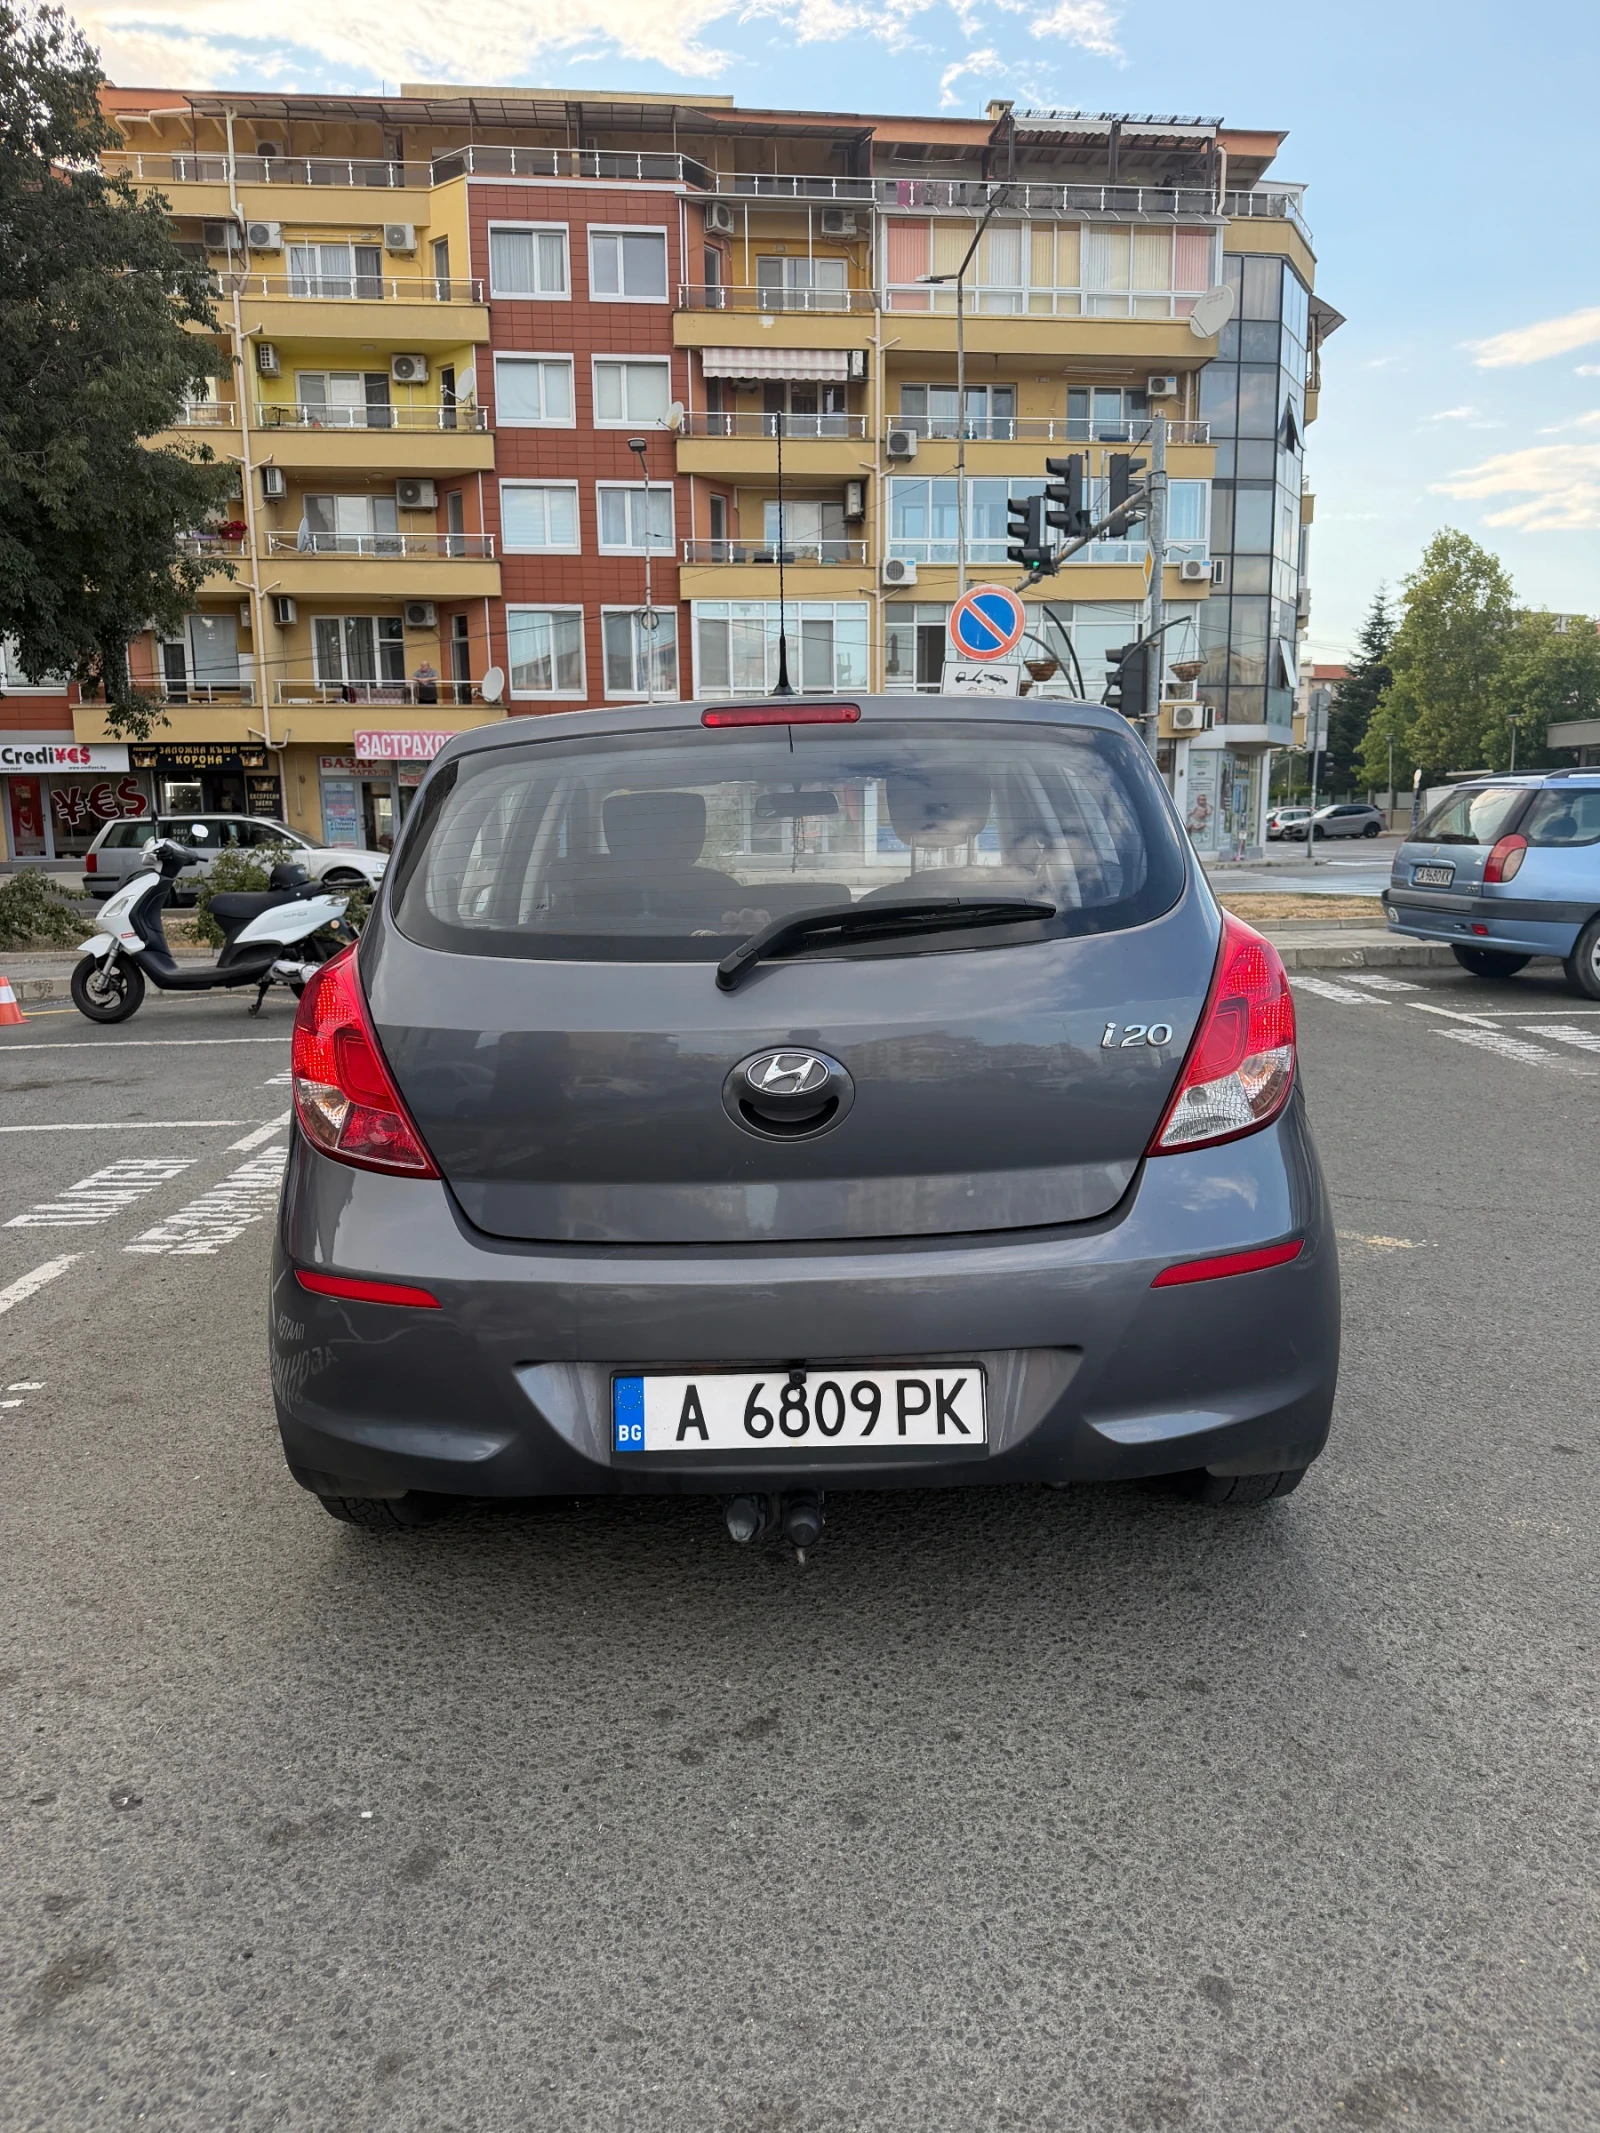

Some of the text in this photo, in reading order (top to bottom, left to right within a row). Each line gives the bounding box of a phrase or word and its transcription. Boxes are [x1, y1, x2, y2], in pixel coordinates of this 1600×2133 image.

[159, 746, 237, 754] ЗАЛОЖНА КЪША
[176, 755, 223, 765] КОРОНА
[322, 758, 378, 768] БАЗАР
[1101, 1022, 1173, 1049] i20
[2, 1156, 199, 1227] ПЛАТЕН
[618, 1425, 642, 1442] BG
